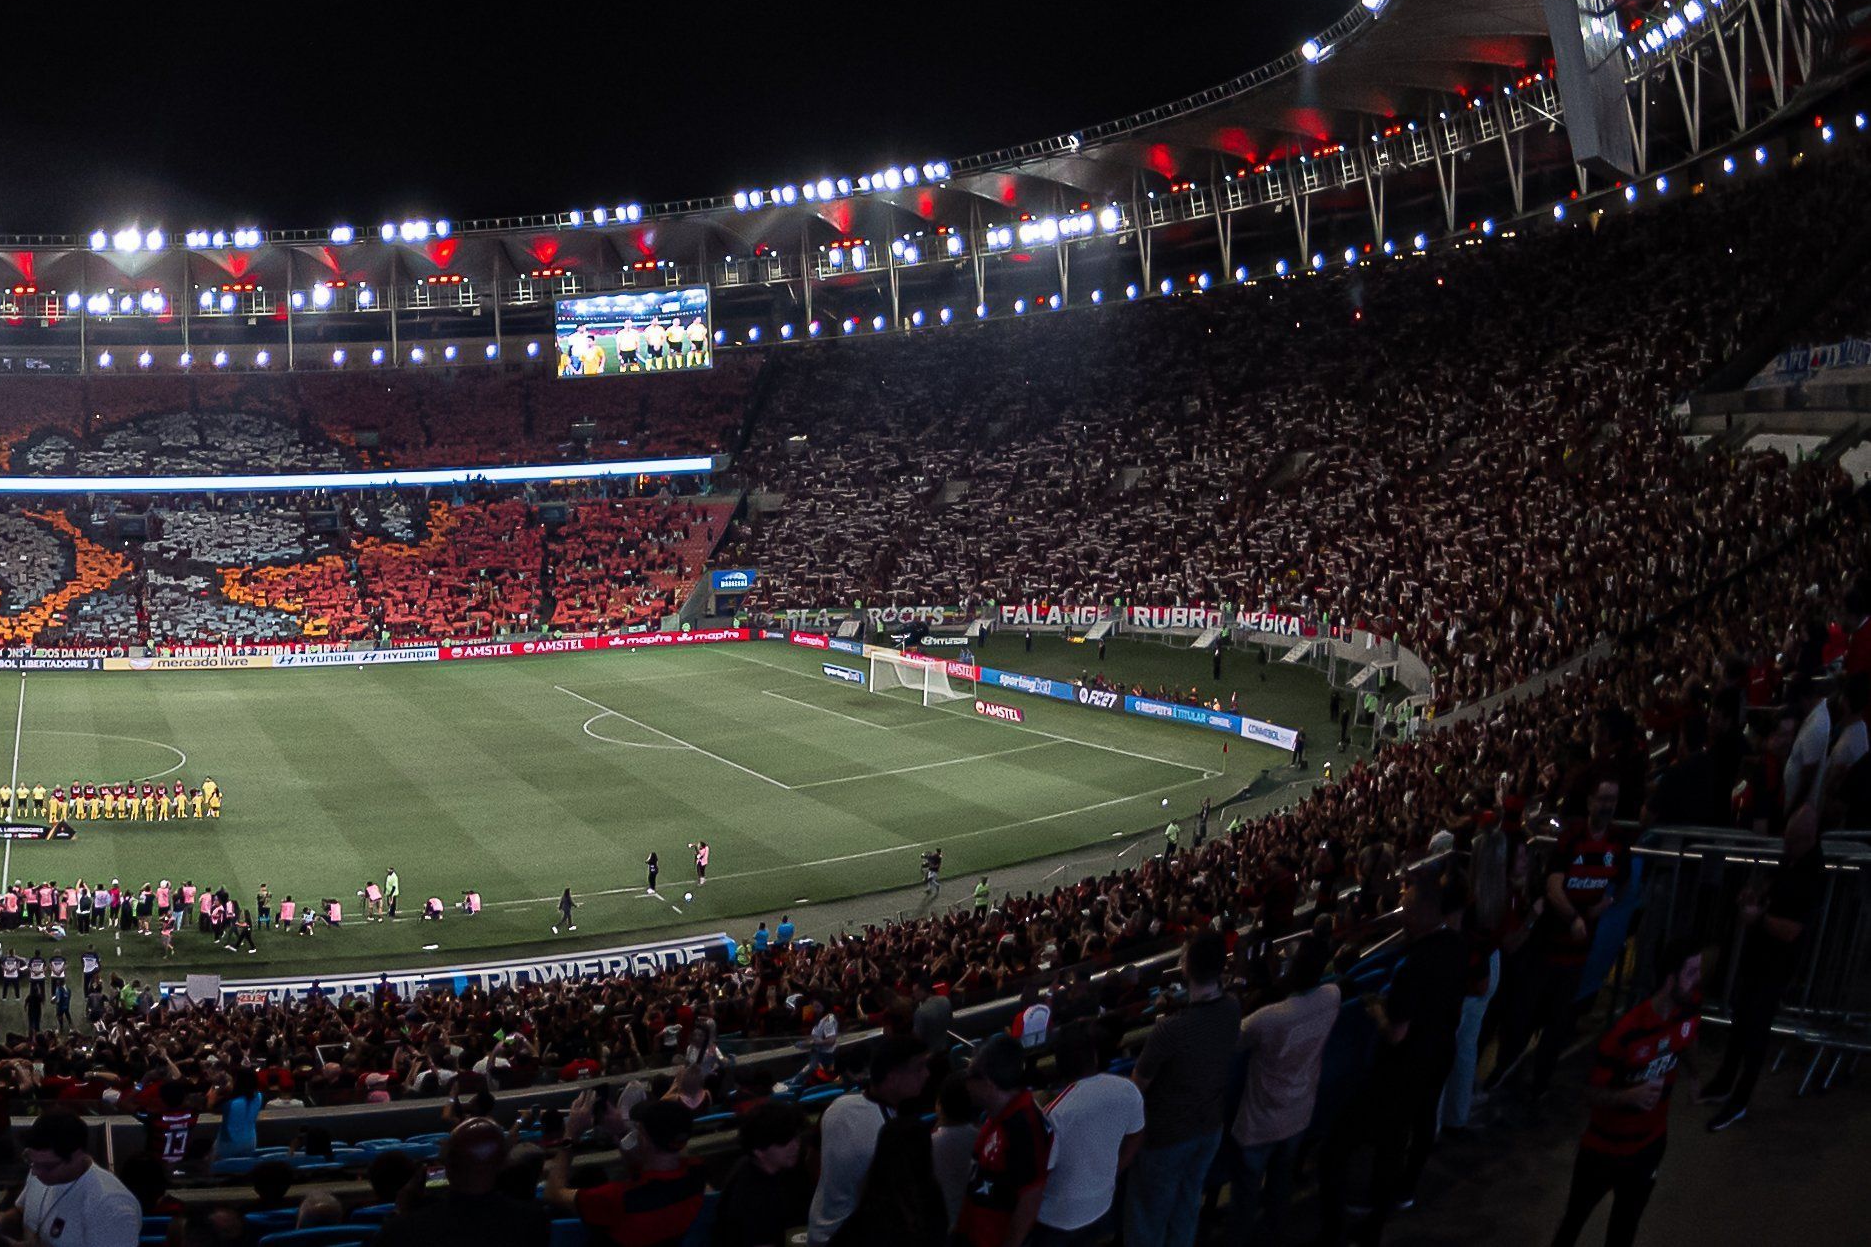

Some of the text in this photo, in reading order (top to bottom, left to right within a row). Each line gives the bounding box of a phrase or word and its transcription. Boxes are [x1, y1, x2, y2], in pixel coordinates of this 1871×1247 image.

[868, 606, 945, 626] ROOTS
[1001, 605, 1301, 637] FALANGE RUBRO NEGRA
[626, 634, 672, 645] mapfre
[695, 630, 740, 641] mapfre
[61, 648, 76, 658] DA
[175, 644, 233, 658] CAMPEÃO
[464, 644, 513, 656] AMSTEL
[537, 640, 584, 652] AMSTEL
[157, 656, 249, 667] mercado livre
[301, 649, 437, 664] HYUNDAI HYUNDAI
[20, 659, 89, 669] LIBERTADORES
[948, 663, 975, 678] AMSTEL
[999, 674, 1051, 695] sportingbet
[984, 703, 1021, 721] AMSTEL
[1178, 708, 1207, 723] TITULAR
[480, 945, 706, 996] POWERADE
